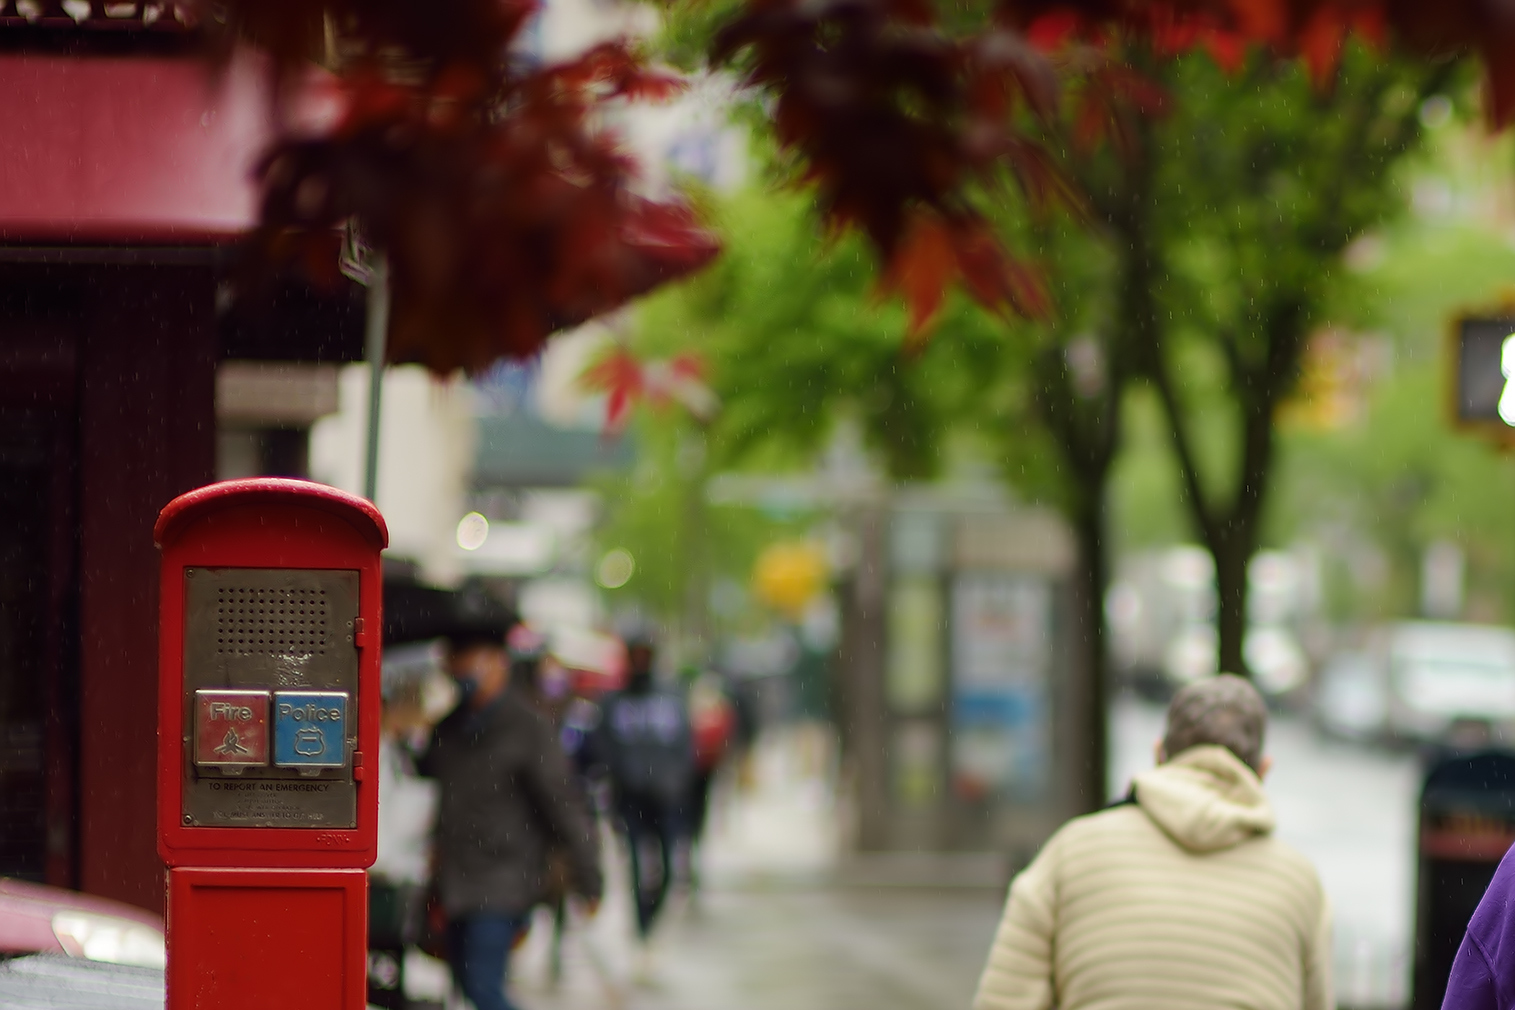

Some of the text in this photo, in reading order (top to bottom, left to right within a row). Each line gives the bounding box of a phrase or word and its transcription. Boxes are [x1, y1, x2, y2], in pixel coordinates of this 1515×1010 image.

[210, 702, 252, 721] Fire
[279, 703, 340, 721] Police
[208, 782, 329, 792] TO REPORT AN EMERGENCY
